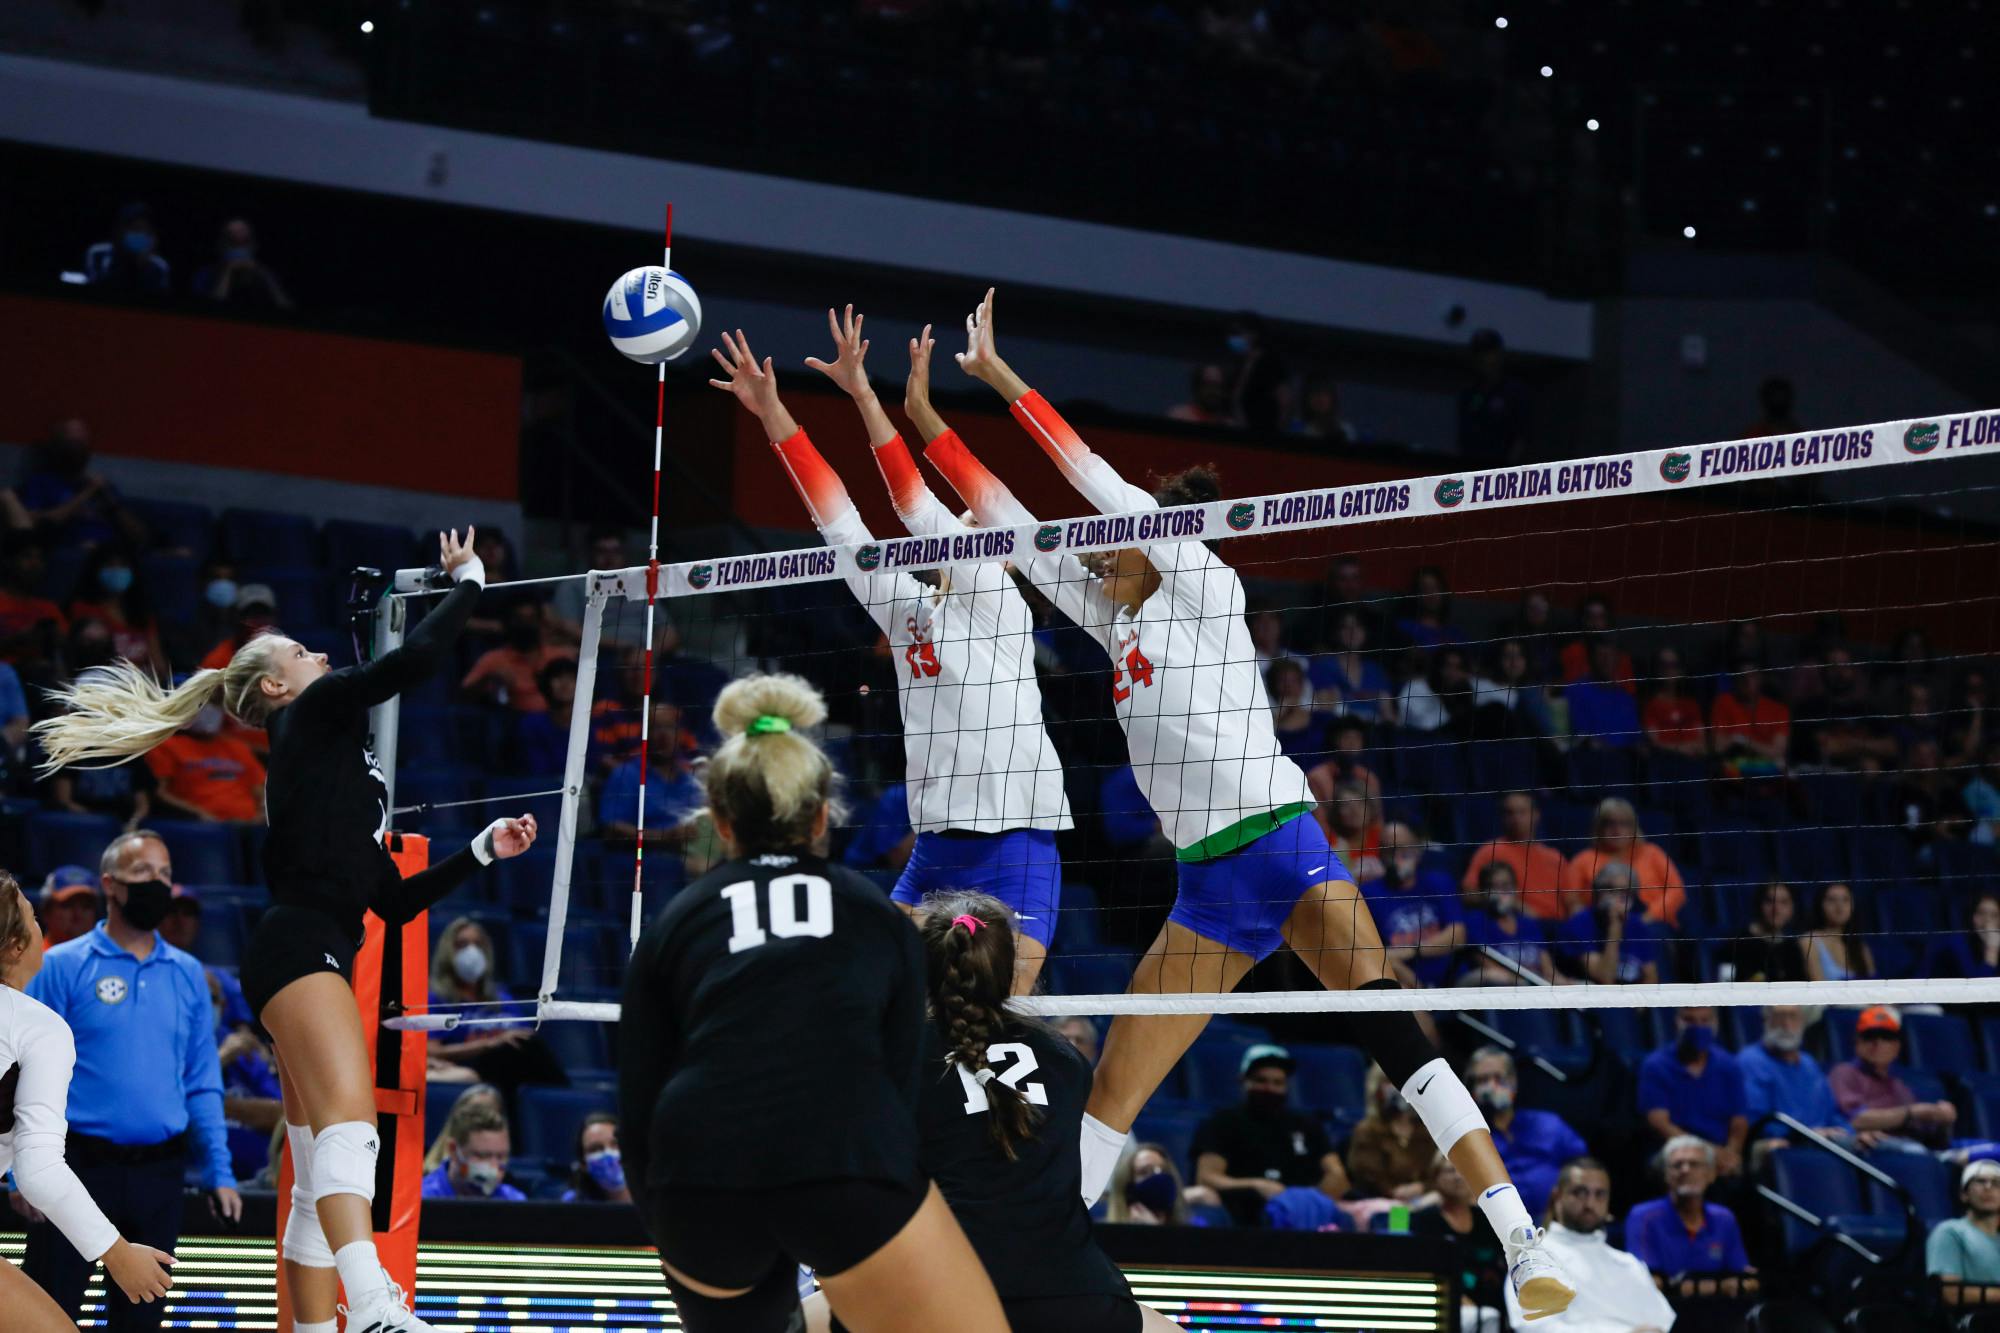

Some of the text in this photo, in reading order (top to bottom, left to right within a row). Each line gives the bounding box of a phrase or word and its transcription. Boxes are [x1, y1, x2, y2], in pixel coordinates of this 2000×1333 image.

[1699, 430, 1874, 478] FLORIDA GATORS
[1470, 459, 1633, 503] FLORIDA GATORS
[1261, 484, 1411, 527] FLORIDA GATORS
[884, 529, 1016, 568] FLORIDA GATORS
[1066, 508, 1206, 548] FLORIDA GATORS
[716, 550, 837, 586] FLORIDA GATORS
[720, 873, 834, 954] 10
[954, 1042, 1049, 1116] 12
